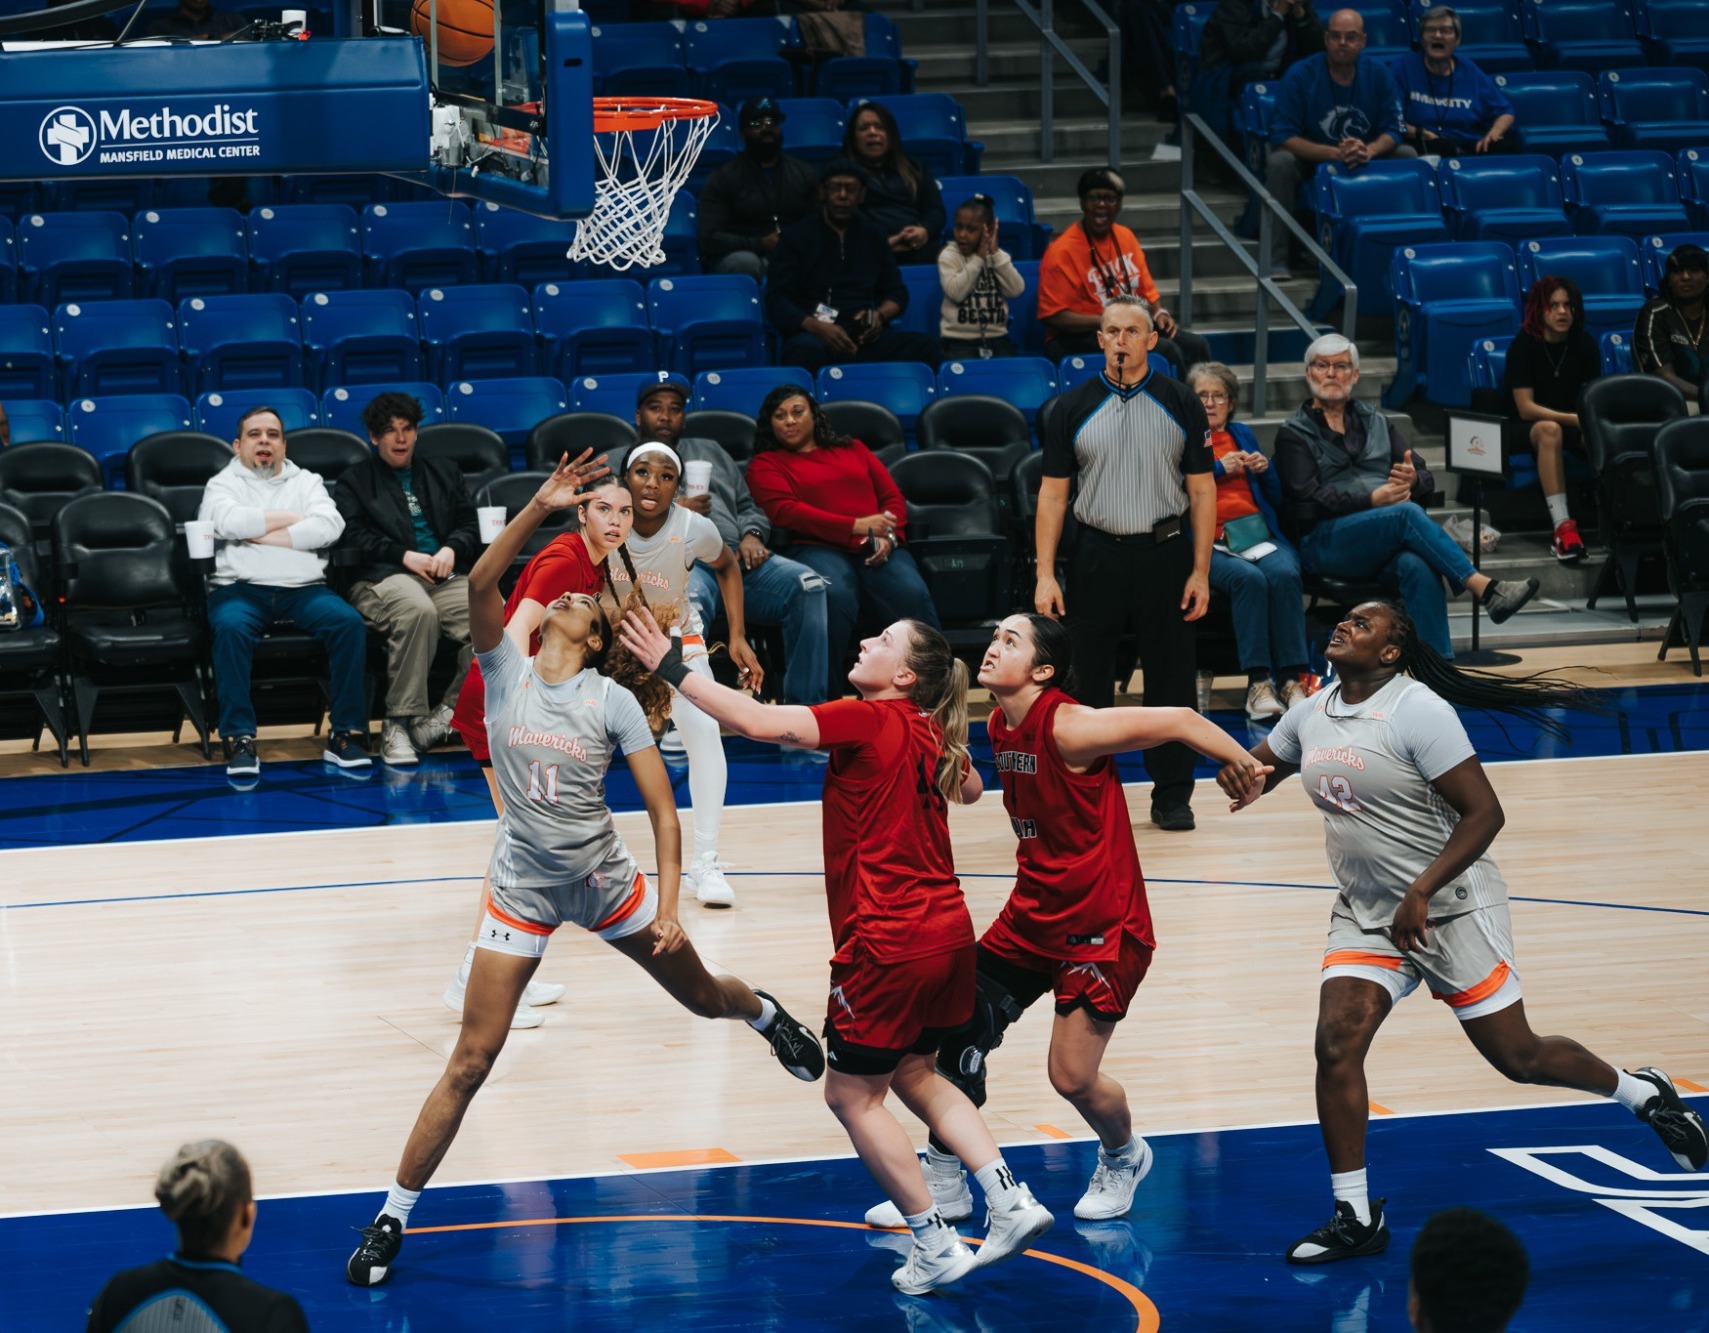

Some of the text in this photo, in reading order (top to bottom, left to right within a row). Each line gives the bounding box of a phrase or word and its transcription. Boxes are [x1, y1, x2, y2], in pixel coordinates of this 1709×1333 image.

[100, 104, 259, 141] Methodist
[100, 145, 261, 163] MANSFIELD MEDICAL CENTER
[658, 370, 670, 384] P
[609, 565, 669, 591] aricks
[508, 725, 588, 762] Mavericks
[1304, 745, 1366, 772] Mavericks
[526, 759, 560, 805] 11
[1317, 773, 1363, 813] 42
